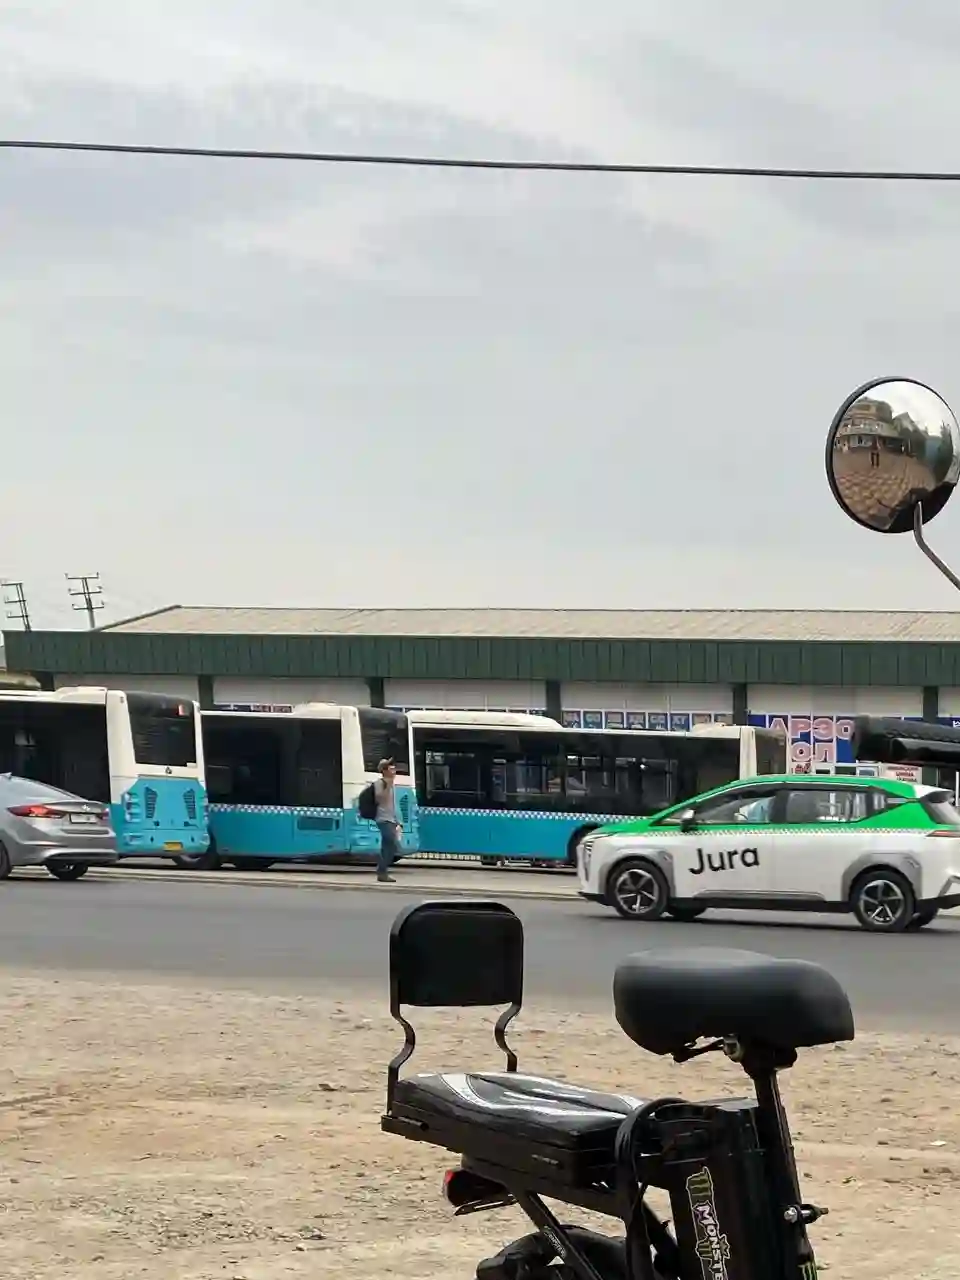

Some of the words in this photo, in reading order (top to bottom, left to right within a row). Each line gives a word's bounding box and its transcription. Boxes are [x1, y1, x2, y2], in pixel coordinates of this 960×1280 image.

[769, 717, 856, 740] АРЗО
[790, 741, 835, 762] ОЛ
[688, 847, 760, 875] Jura
